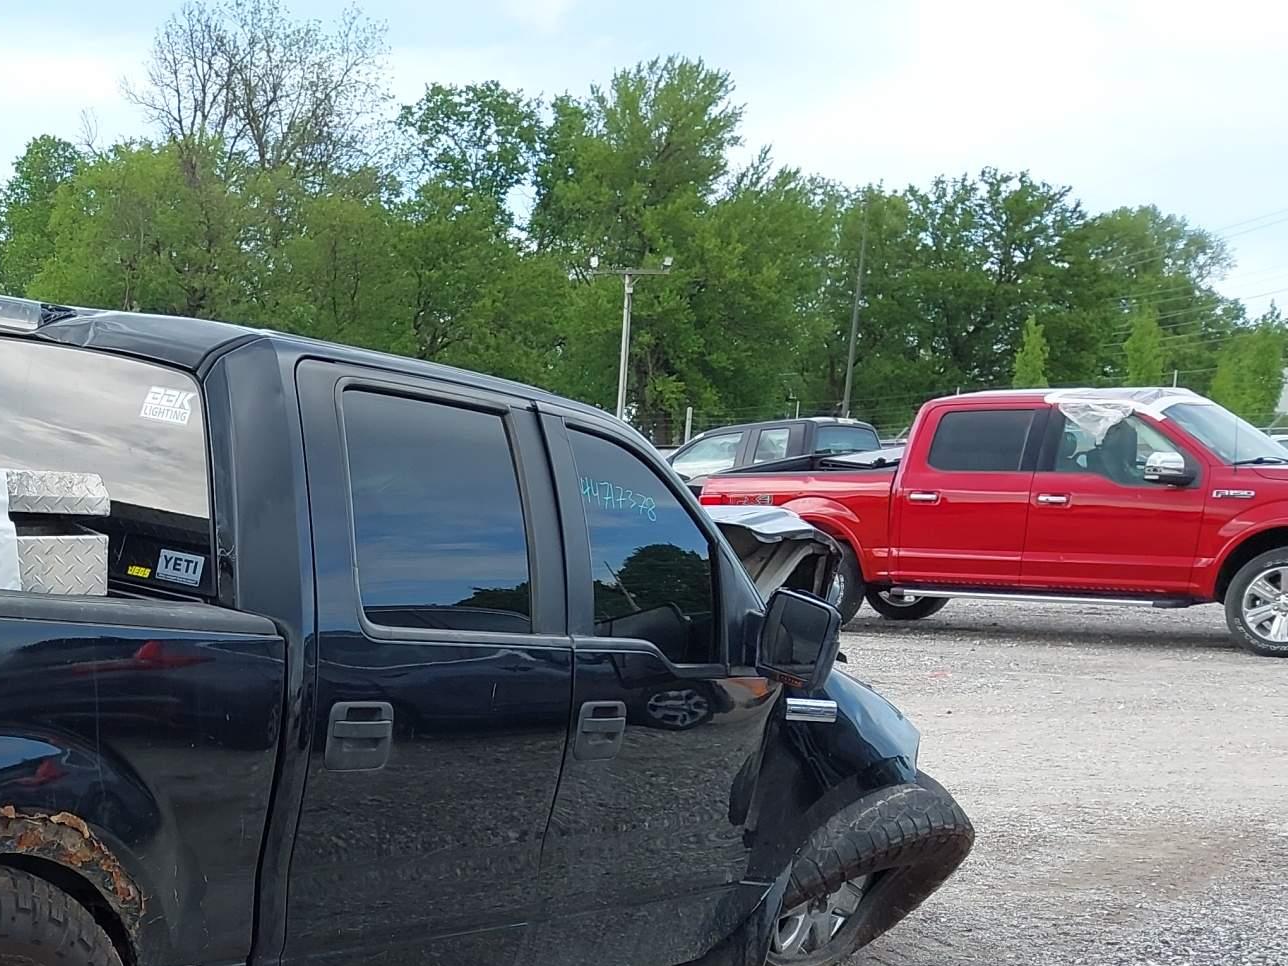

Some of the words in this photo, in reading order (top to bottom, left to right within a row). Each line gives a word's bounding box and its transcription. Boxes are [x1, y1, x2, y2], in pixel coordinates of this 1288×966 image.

[143, 404, 187, 421] LIGHTING
[580, 476, 656, 521] 44717378
[164, 554, 199, 575] YETI
